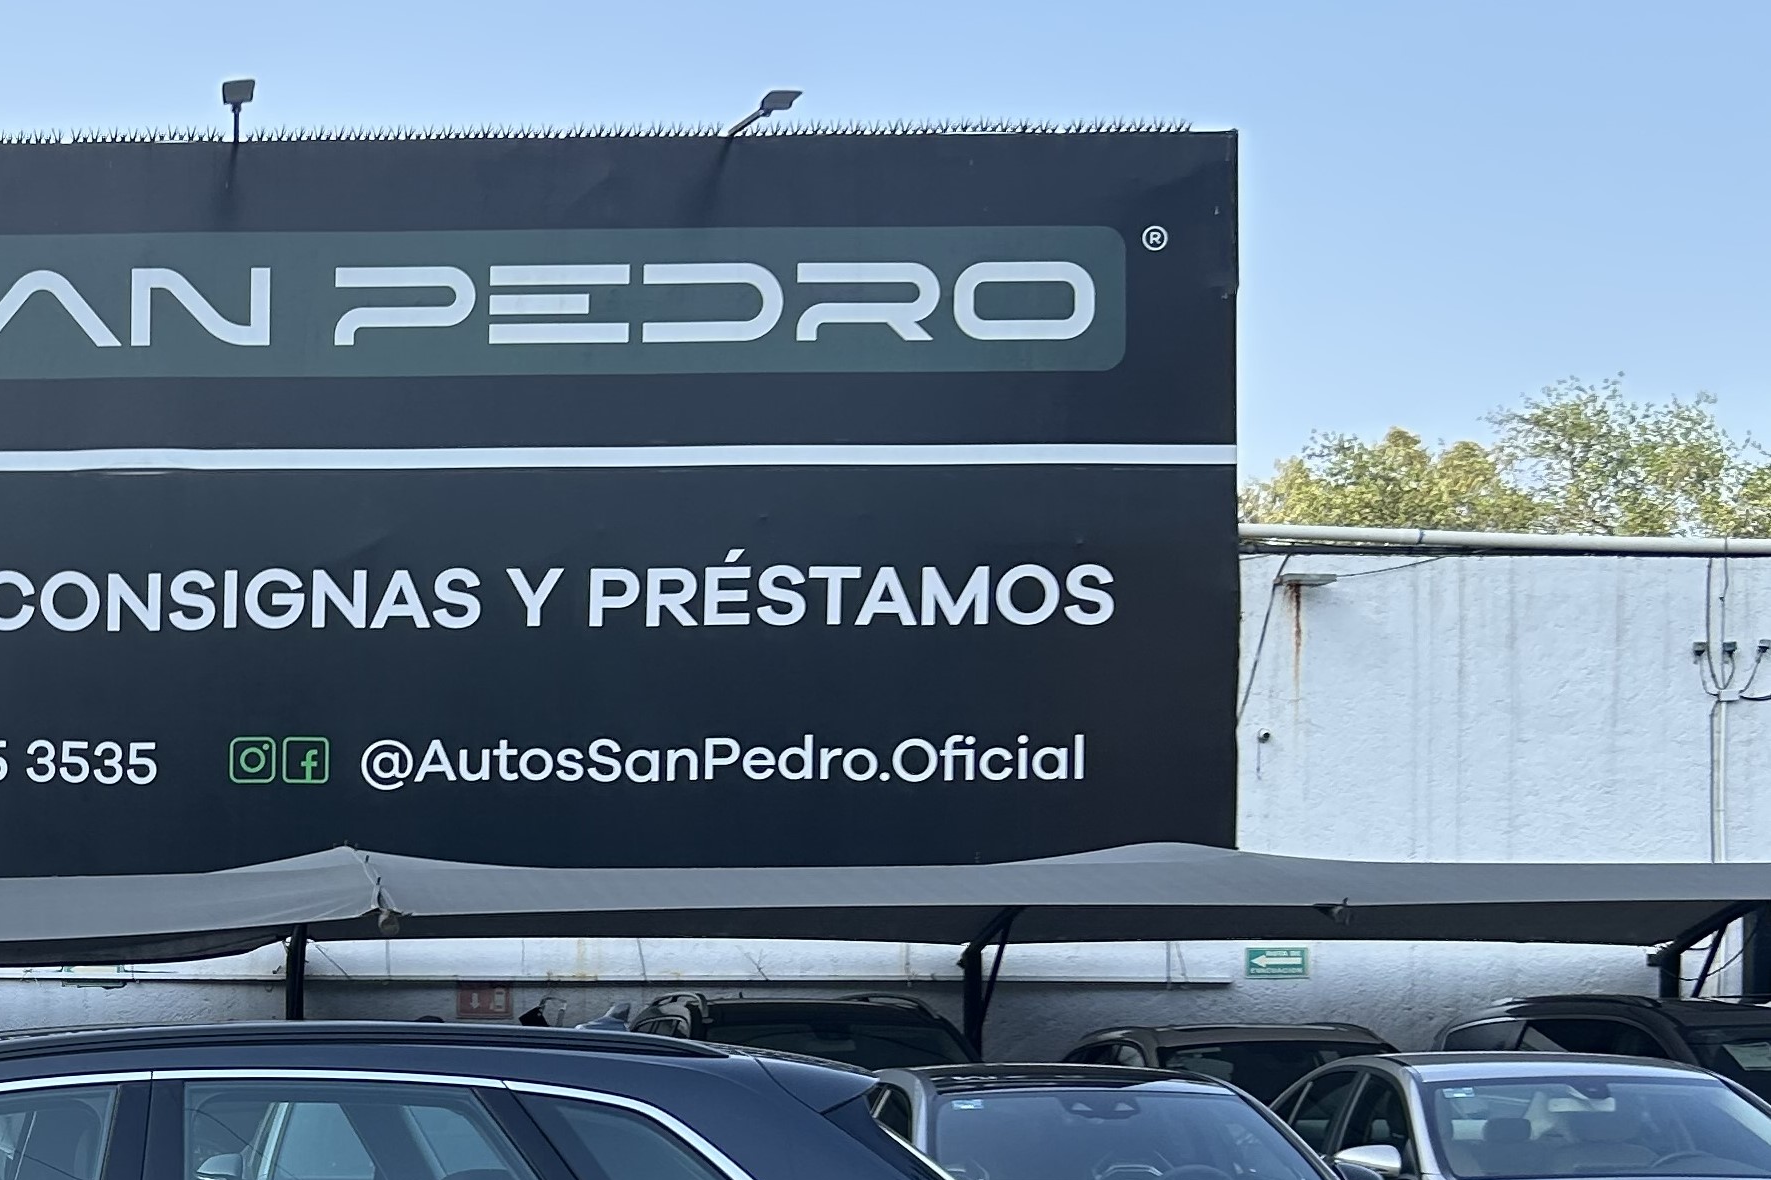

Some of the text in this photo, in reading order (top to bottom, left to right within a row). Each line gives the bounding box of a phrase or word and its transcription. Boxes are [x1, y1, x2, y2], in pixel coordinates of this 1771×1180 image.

[335, 261, 1096, 346] PEDRO
[505, 567, 565, 627] Y
[588, 548, 1115, 628] PRÉSTAMOS
[26, 739, 158, 786] 3535
[360, 734, 1086, 791] @AutosSanPedro.Oficial
